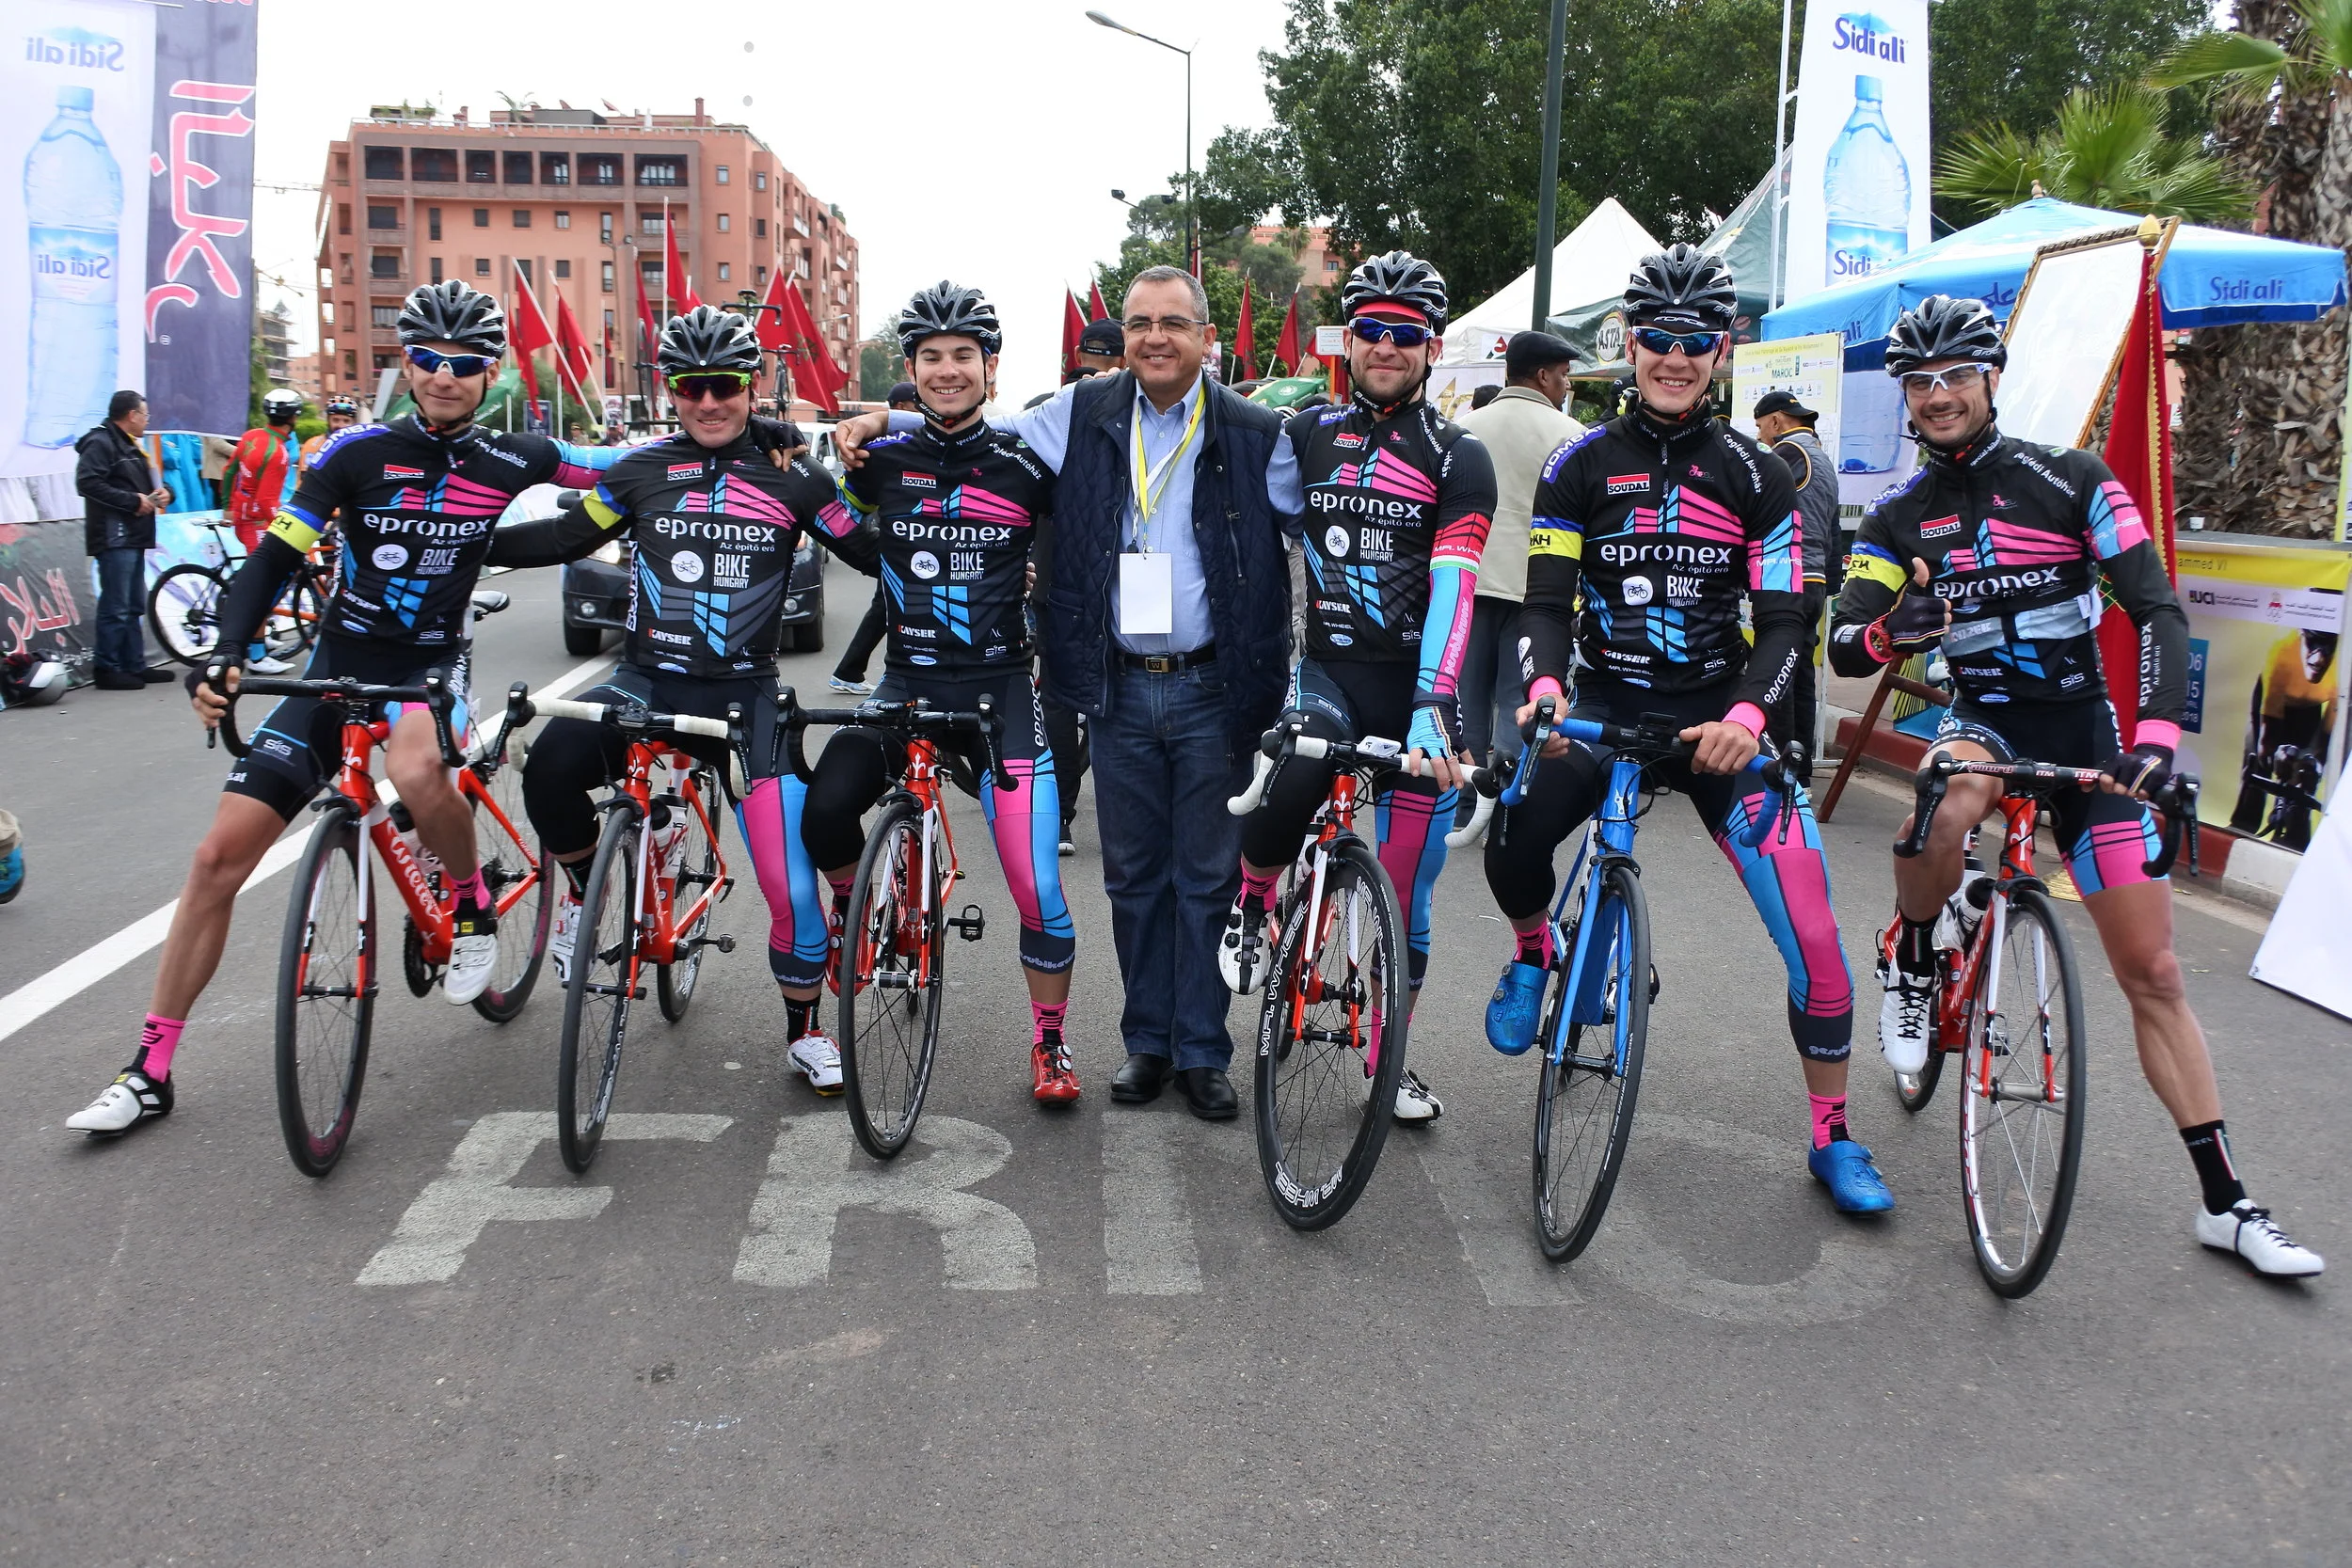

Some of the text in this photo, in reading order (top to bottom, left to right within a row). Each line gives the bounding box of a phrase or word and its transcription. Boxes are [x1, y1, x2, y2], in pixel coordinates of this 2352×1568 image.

[1833, 17, 1906, 64] Sidi ali
[2209, 277, 2284, 302] Sidi ali
[1653, 315, 1708, 328] FORCE
[1772, 367, 1793, 378] MAROC
[1723, 433, 1747, 461] Ceglédi
[667, 468, 703, 481] SOUDAL
[903, 477, 937, 487] SOUDAL
[1608, 482, 1650, 494] SOUDAL
[1310, 491, 1422, 519] epronex
[363, 514, 491, 536] epronex
[655, 517, 776, 544] epronex
[892, 519, 1012, 542] epronex
[1378, 516, 1403, 527] építő
[1921, 522, 1961, 538] SOUDAL
[720, 542, 733, 550] Az
[735, 543, 759, 552] építő
[1360, 528, 1394, 552] BIKE
[420, 547, 461, 566] BIKE
[950, 551, 985, 571] BIKE
[1359, 549, 1394, 562] HUNGARY
[1601, 544, 1733, 566] epronex
[2178, 558, 2214, 571] ammed
[714, 553, 752, 578] BIKE
[1672, 563, 1685, 572] Az
[713, 576, 750, 589] HUNGARY
[950, 570, 985, 581] HUNGARY
[1933, 566, 2062, 599] epronex
[1666, 575, 1705, 599] BIKE
[2194, 592, 2216, 606] UCI
[2138, 621, 2153, 707] epronex
[1763, 647, 1799, 705] epronex
[2035, 769, 2100, 780] ITM ITM
[1275, 1161, 1320, 1208] WHEEL
